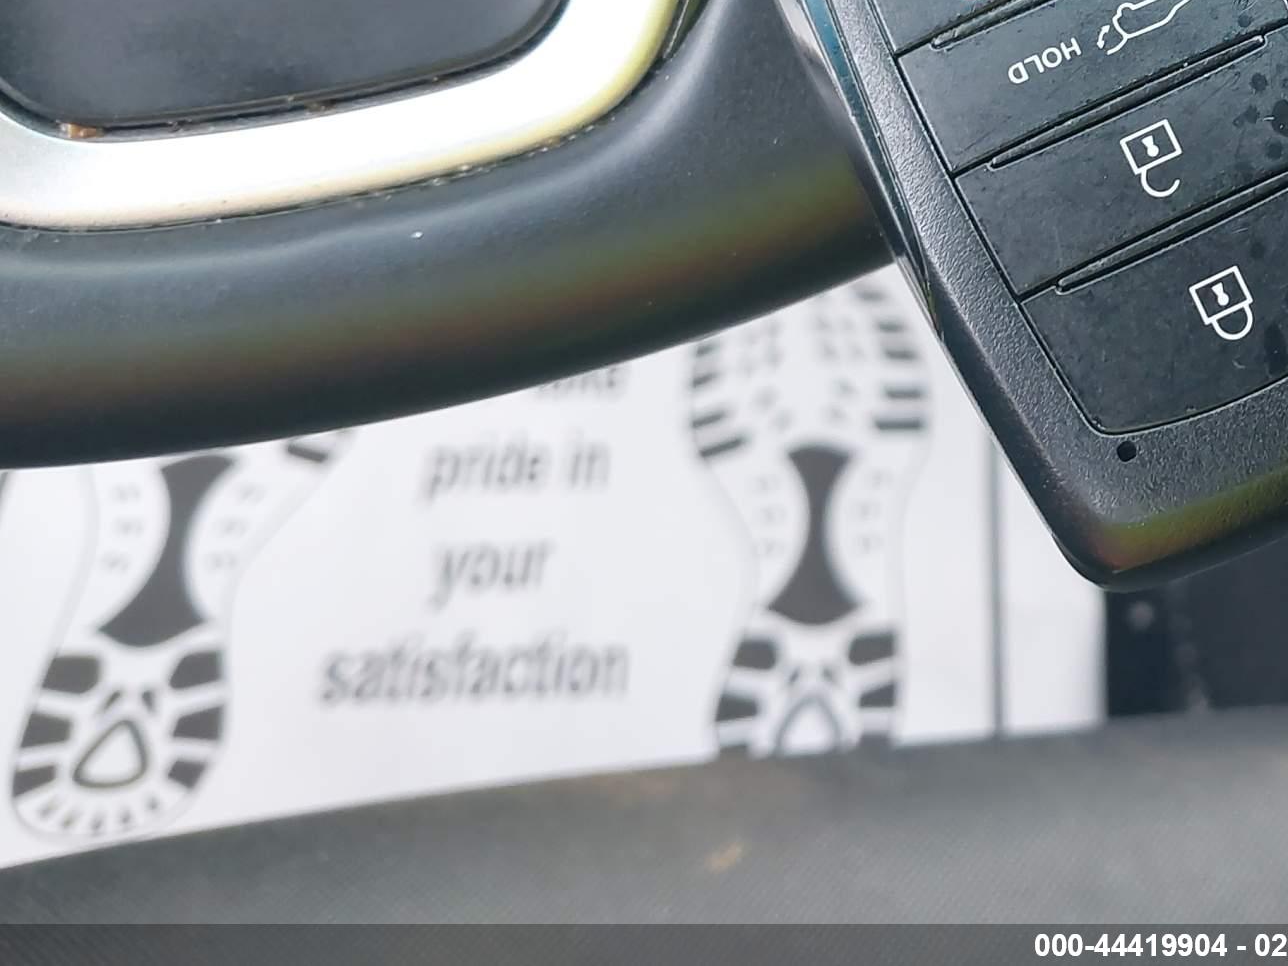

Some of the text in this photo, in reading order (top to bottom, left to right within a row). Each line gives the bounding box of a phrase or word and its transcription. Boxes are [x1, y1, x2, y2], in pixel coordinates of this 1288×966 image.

[1007, 37, 1082, 84] HOLD
[420, 433, 611, 503] pride in
[429, 538, 556, 610] your
[320, 630, 631, 704] satisfaction
